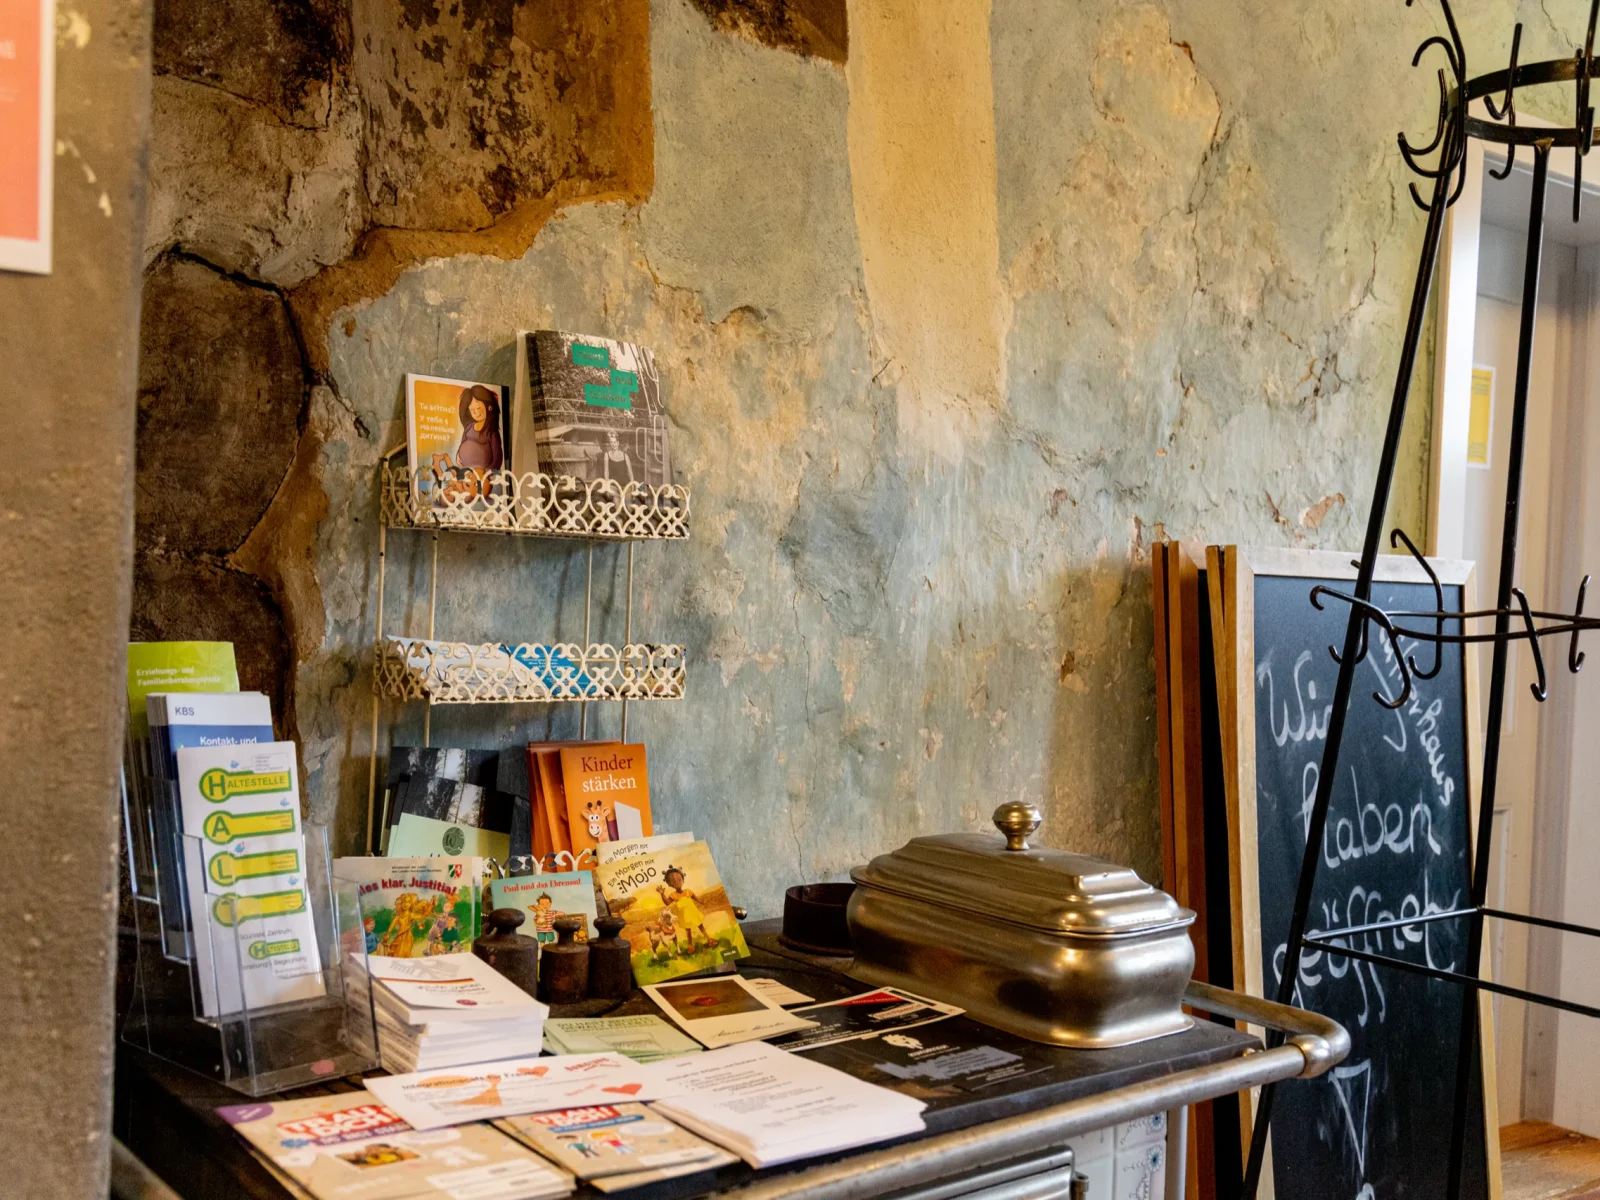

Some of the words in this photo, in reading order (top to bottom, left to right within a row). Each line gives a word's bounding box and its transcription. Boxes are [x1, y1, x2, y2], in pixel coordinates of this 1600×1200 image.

[1257, 650, 1349, 747] Wir
[175, 706, 195, 716] KBS
[200, 736, 238, 746] Kontakt-
[240, 736, 257, 745] und
[581, 754, 634, 772] Kinder
[208, 774, 286, 796] HALTESTELLE
[582, 774, 637, 793] stärken
[1302, 762, 1441, 868] haben
[212, 816, 231, 837] A
[613, 843, 639, 859] Morgen
[217, 859, 233, 880] L
[607, 877, 617, 888] Ein
[615, 860, 643, 878] Morgen
[644, 858, 655, 866] mit
[620, 867, 657, 893] Mojo
[360, 882, 379, 896] les
[409, 876, 457, 895] Justitia!
[503, 883, 519, 893] Paul
[521, 883, 535, 891] und
[1273, 868, 1461, 1027] geöffnet
